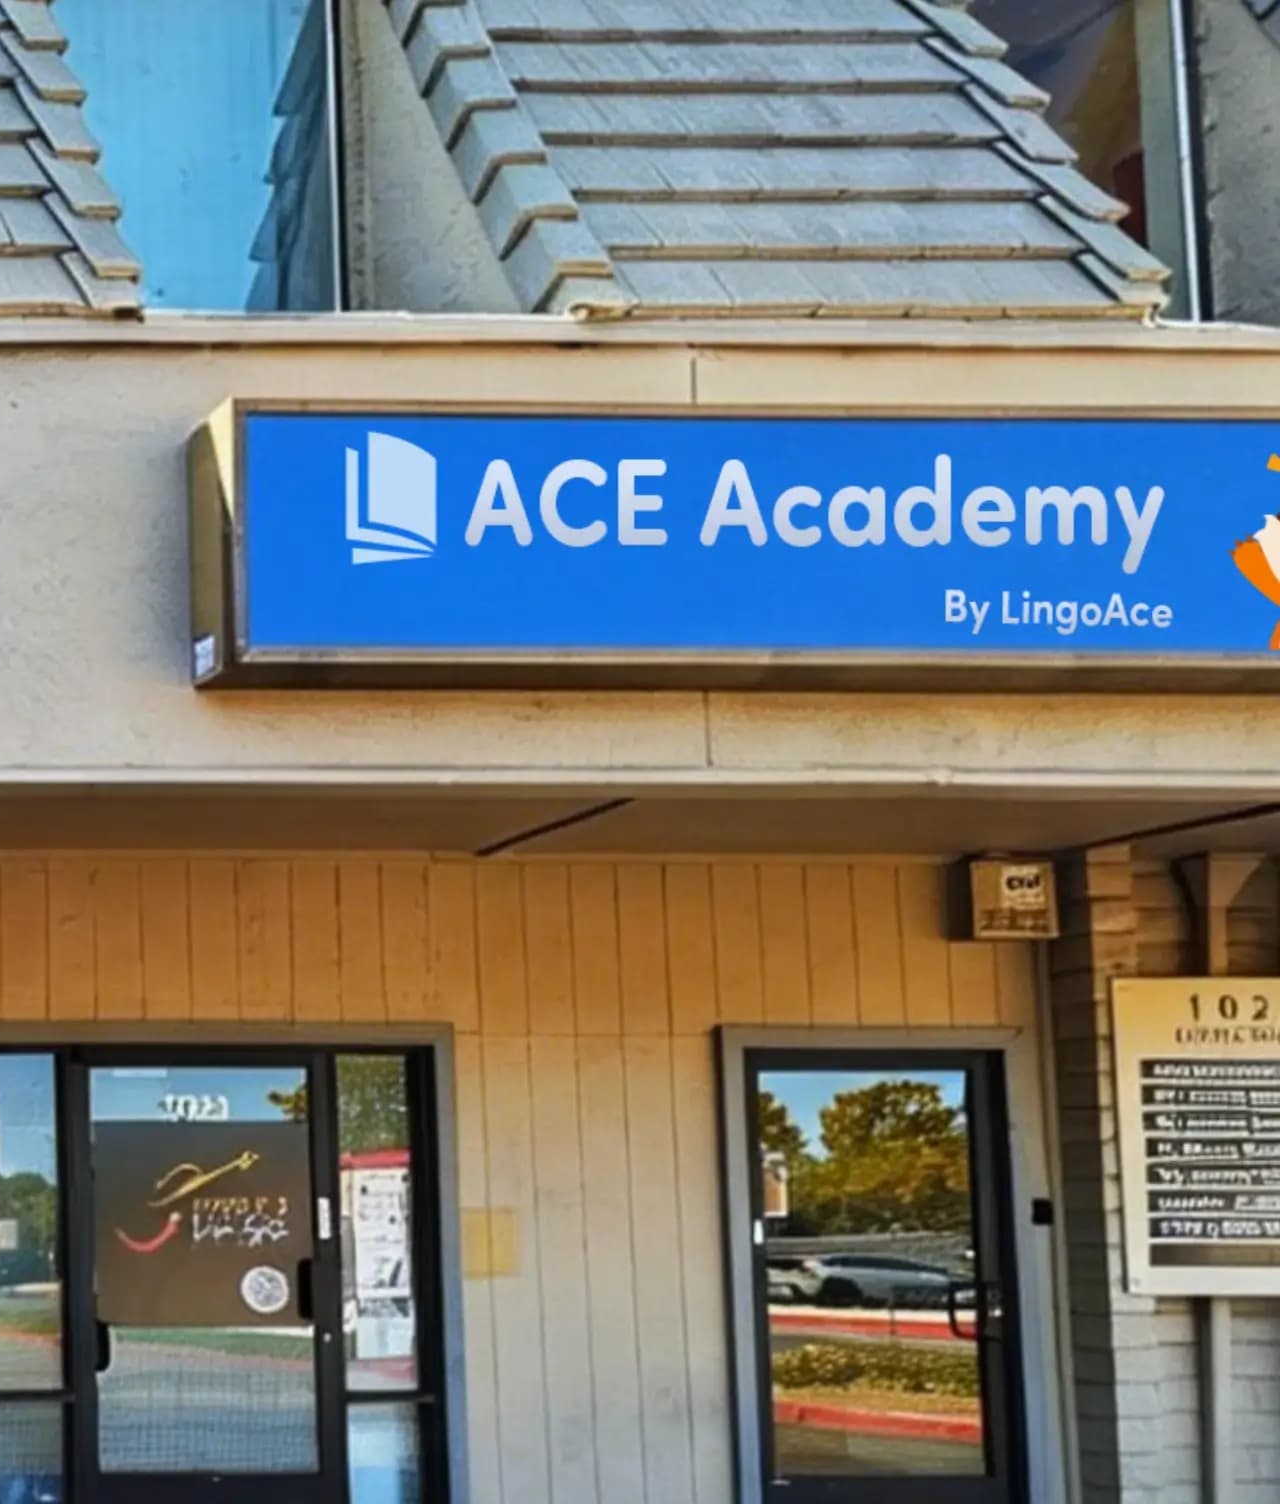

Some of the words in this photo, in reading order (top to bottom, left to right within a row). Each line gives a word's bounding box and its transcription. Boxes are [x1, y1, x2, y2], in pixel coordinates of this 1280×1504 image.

[464, 458, 668, 548] ACE
[699, 453, 1165, 575] Academy
[944, 588, 991, 635] By
[1001, 590, 1174, 635] LingoAce
